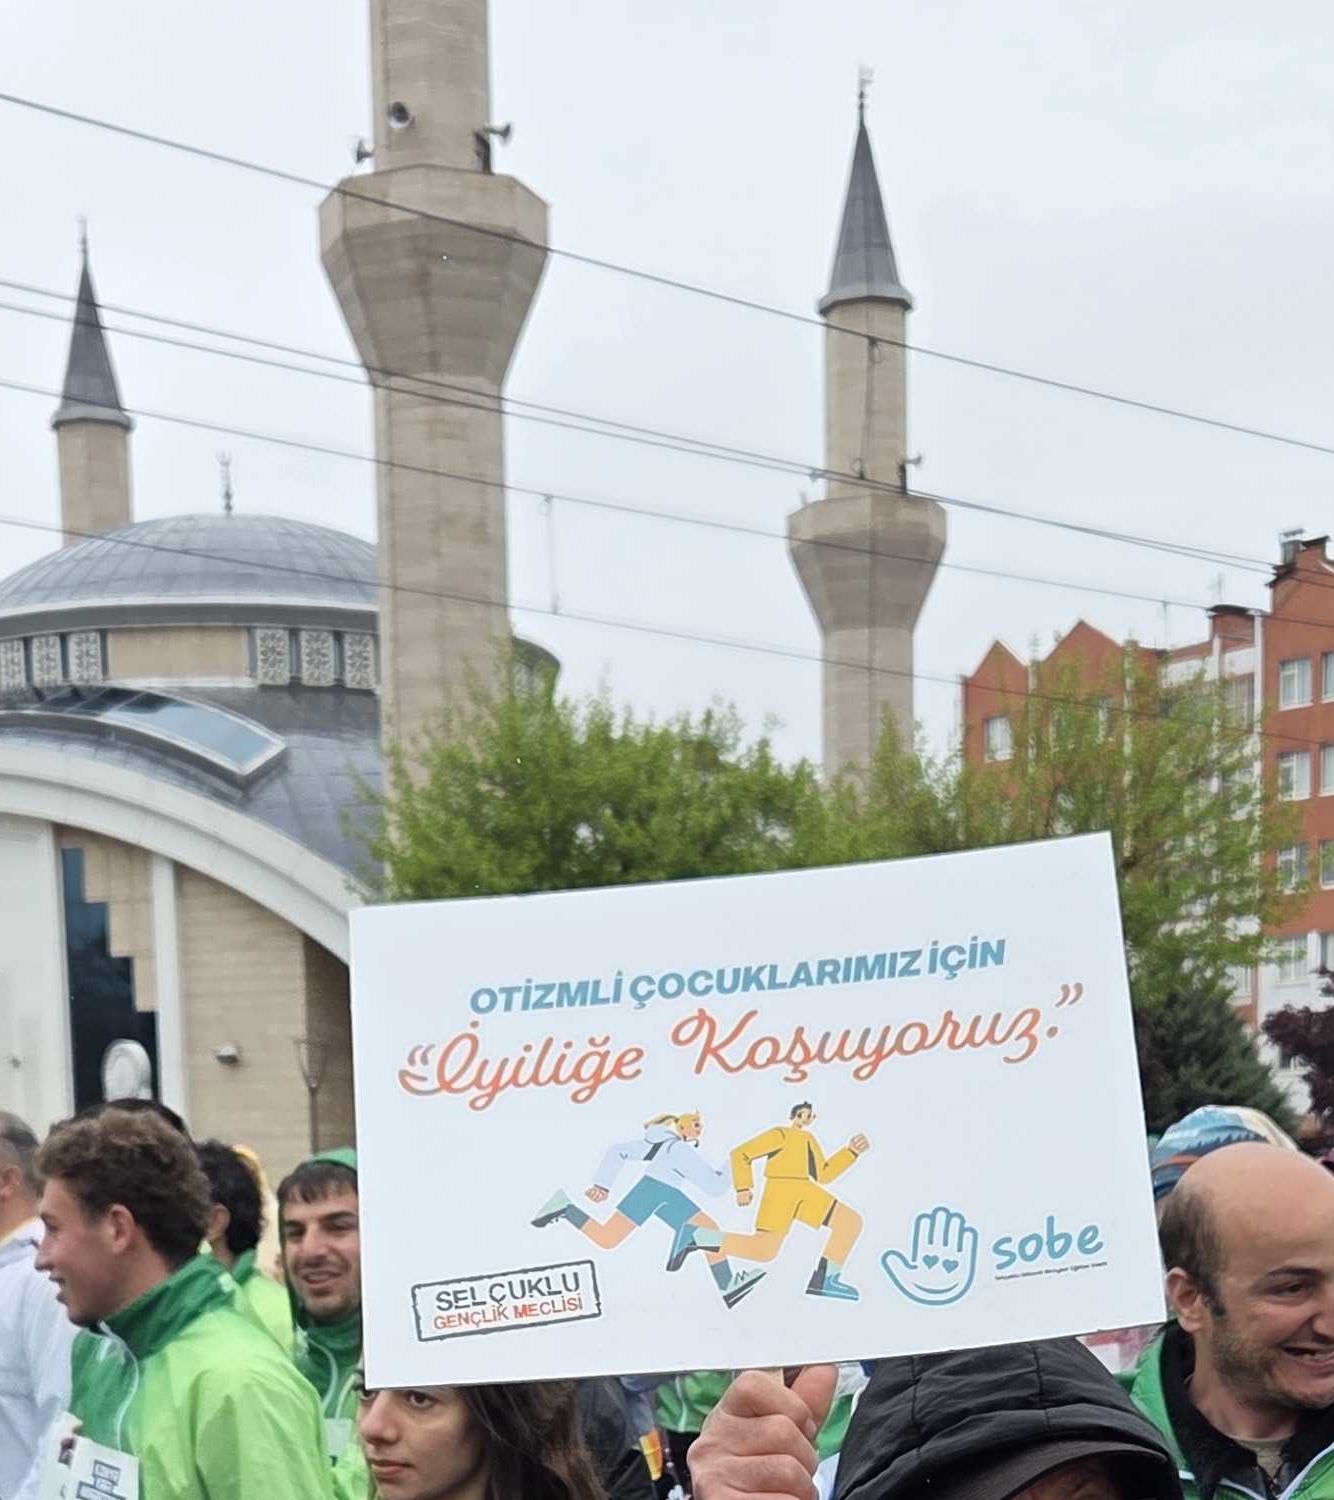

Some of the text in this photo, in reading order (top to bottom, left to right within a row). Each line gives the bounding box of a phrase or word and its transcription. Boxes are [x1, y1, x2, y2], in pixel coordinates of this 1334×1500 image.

[470, 936, 1005, 1014] OTİZMLİ ÇOCUKLARIMIZ İÇİN
[992, 1215, 1103, 1270] sobe
[434, 1293, 583, 1330] GENÇLİK MECLİSİ
[435, 1272, 580, 1311] SELÇUKLU
